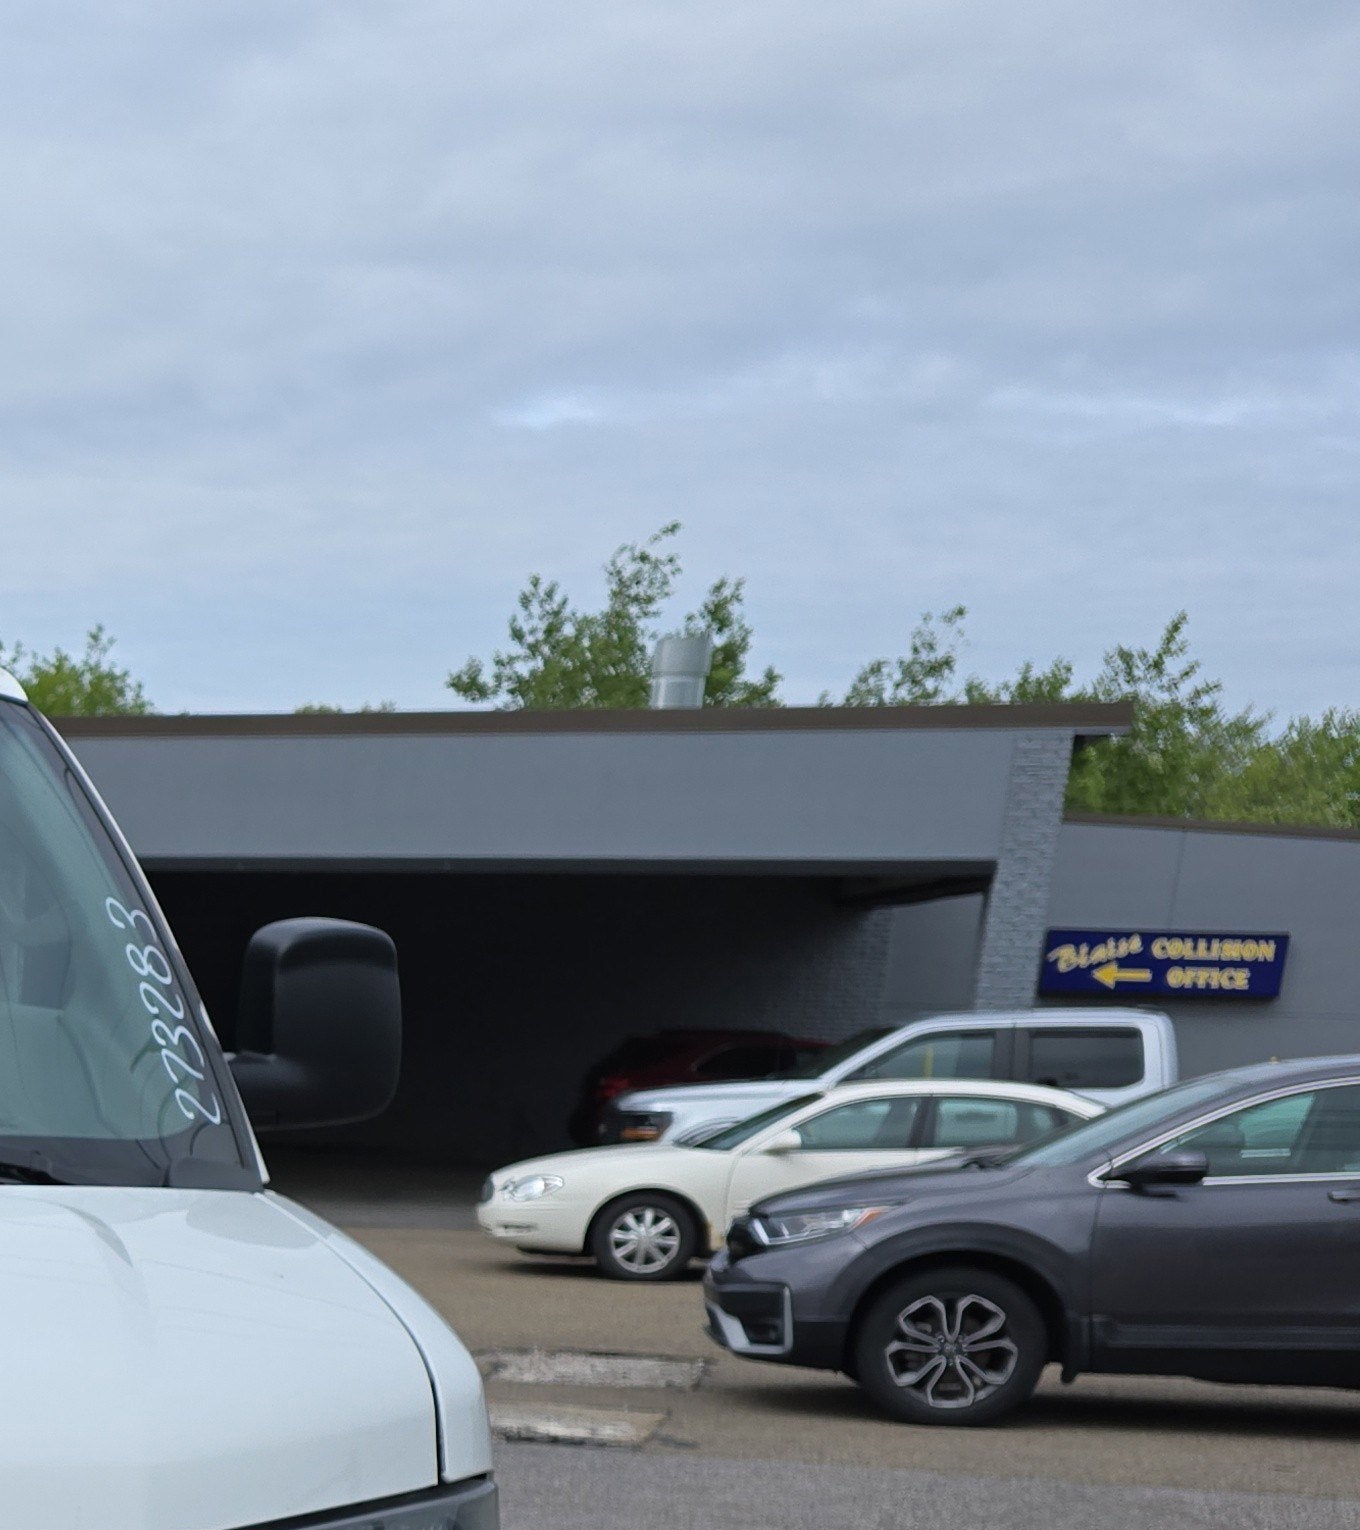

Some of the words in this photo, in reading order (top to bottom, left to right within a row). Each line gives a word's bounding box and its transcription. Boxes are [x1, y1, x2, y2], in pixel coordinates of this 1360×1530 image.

[1151, 936, 1277, 962] COLLISION
[1166, 966, 1251, 989] OFFICE
[105, 896, 221, 1125] 273283
